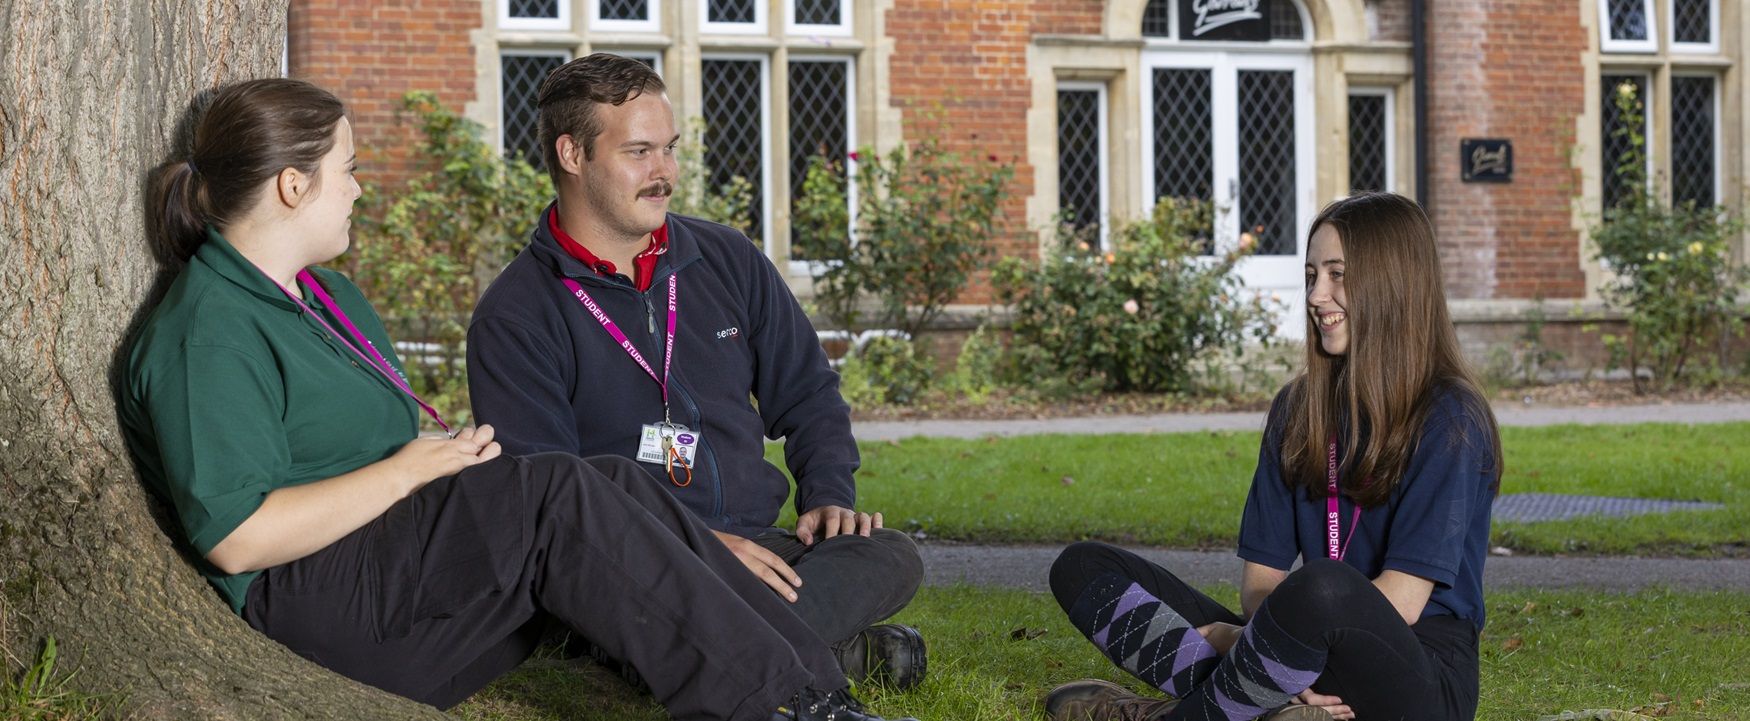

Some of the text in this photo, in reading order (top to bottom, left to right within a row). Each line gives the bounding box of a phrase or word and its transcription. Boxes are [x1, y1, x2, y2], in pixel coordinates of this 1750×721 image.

[575, 289, 611, 326] STUDENT
[668, 274, 676, 312] STUDEN
[622, 340, 655, 376] STUDENT
[1328, 443, 1337, 489] STUDENT
[1328, 511, 1339, 559] STUDENT
